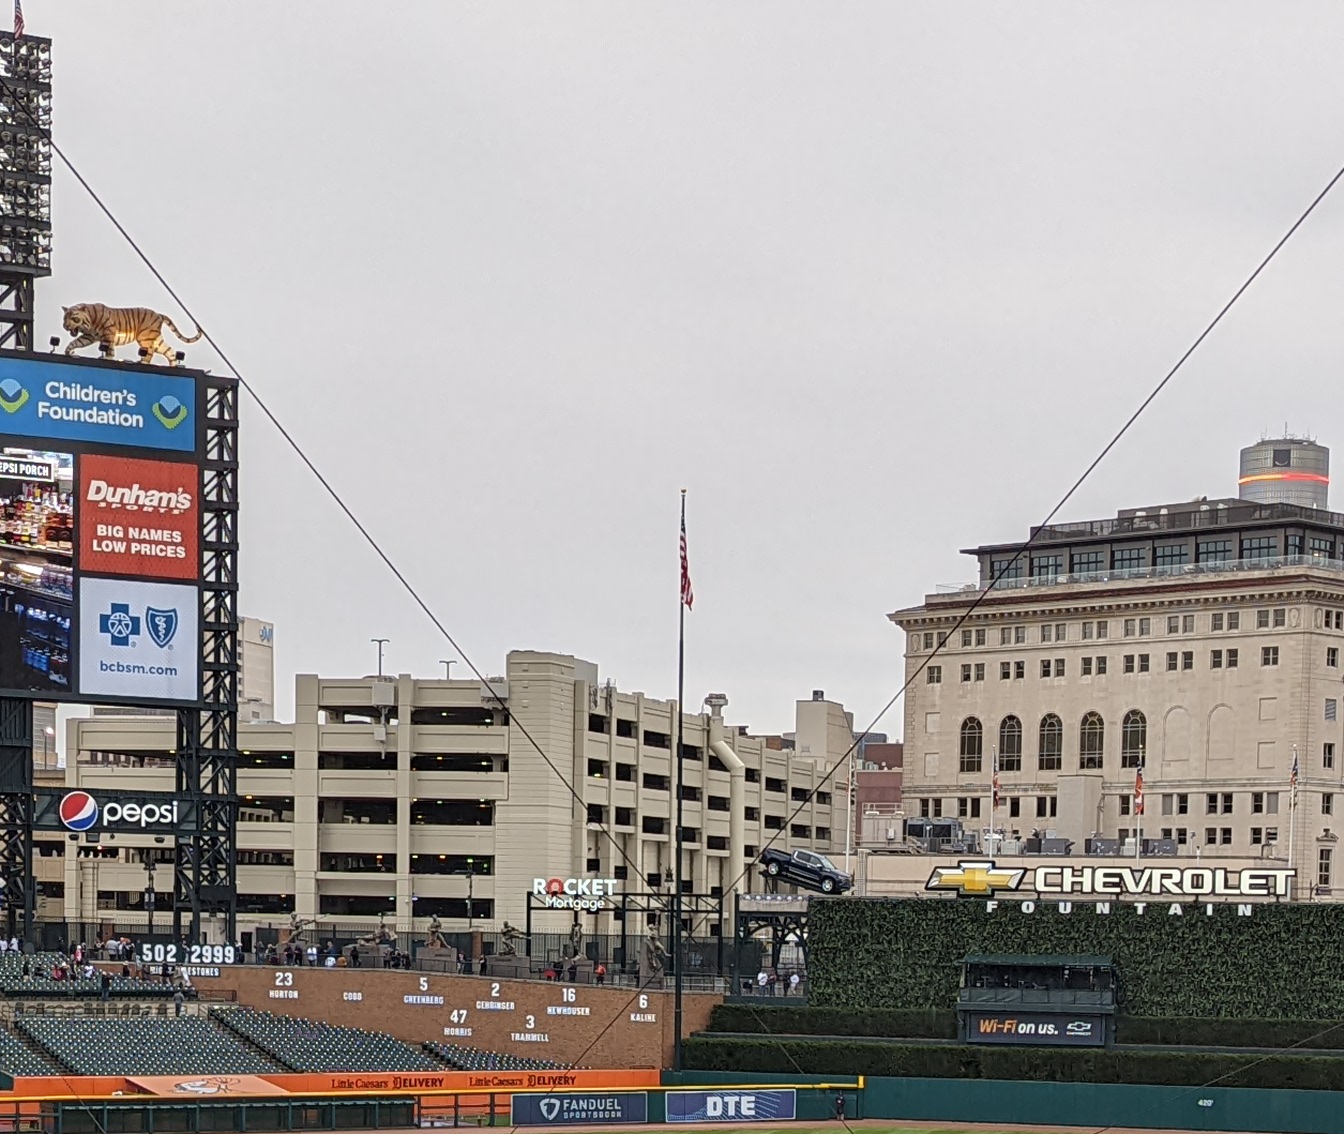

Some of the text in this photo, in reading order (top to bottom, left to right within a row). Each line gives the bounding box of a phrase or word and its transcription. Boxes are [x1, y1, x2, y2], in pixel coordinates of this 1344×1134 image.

[45, 381, 137, 407] Children's
[38, 403, 144, 428] Foundation
[19, 463, 49, 477] PORCH
[87, 480, 192, 510] Dunham's
[97, 524, 182, 543] BIG NAMES
[93, 539, 186, 559] LOW PRICES
[99, 660, 178, 677] bcbsm.com
[102, 800, 178, 828] pepsi
[533, 878, 617, 896] ROCKET
[1034, 867, 1296, 895] CHEVROLET
[545, 897, 605, 911] Mortgage
[986, 901, 1253, 916] FOUNTAIN
[142, 944, 235, 964] 502 2999
[275, 972, 293, 986] 23
[419, 977, 428, 991] 5
[491, 983, 500, 997] 2
[562, 988, 576, 1002] 16
[639, 994, 648, 1009] 6
[450, 1009, 467, 1024] 47
[525, 1015, 535, 1029] 3
[979, 1019, 1059, 1035] Wi-Fi on us.
[331, 1078, 355, 1090] Little
[356, 1078, 389, 1089] Caesars
[469, 1077, 491, 1088] Little
[492, 1077, 523, 1088] Caesars
[563, 1098, 622, 1111] FANDUEL
[707, 1096, 757, 1117] DTE
[564, 1111, 622, 1120] SPORTSBOOK
